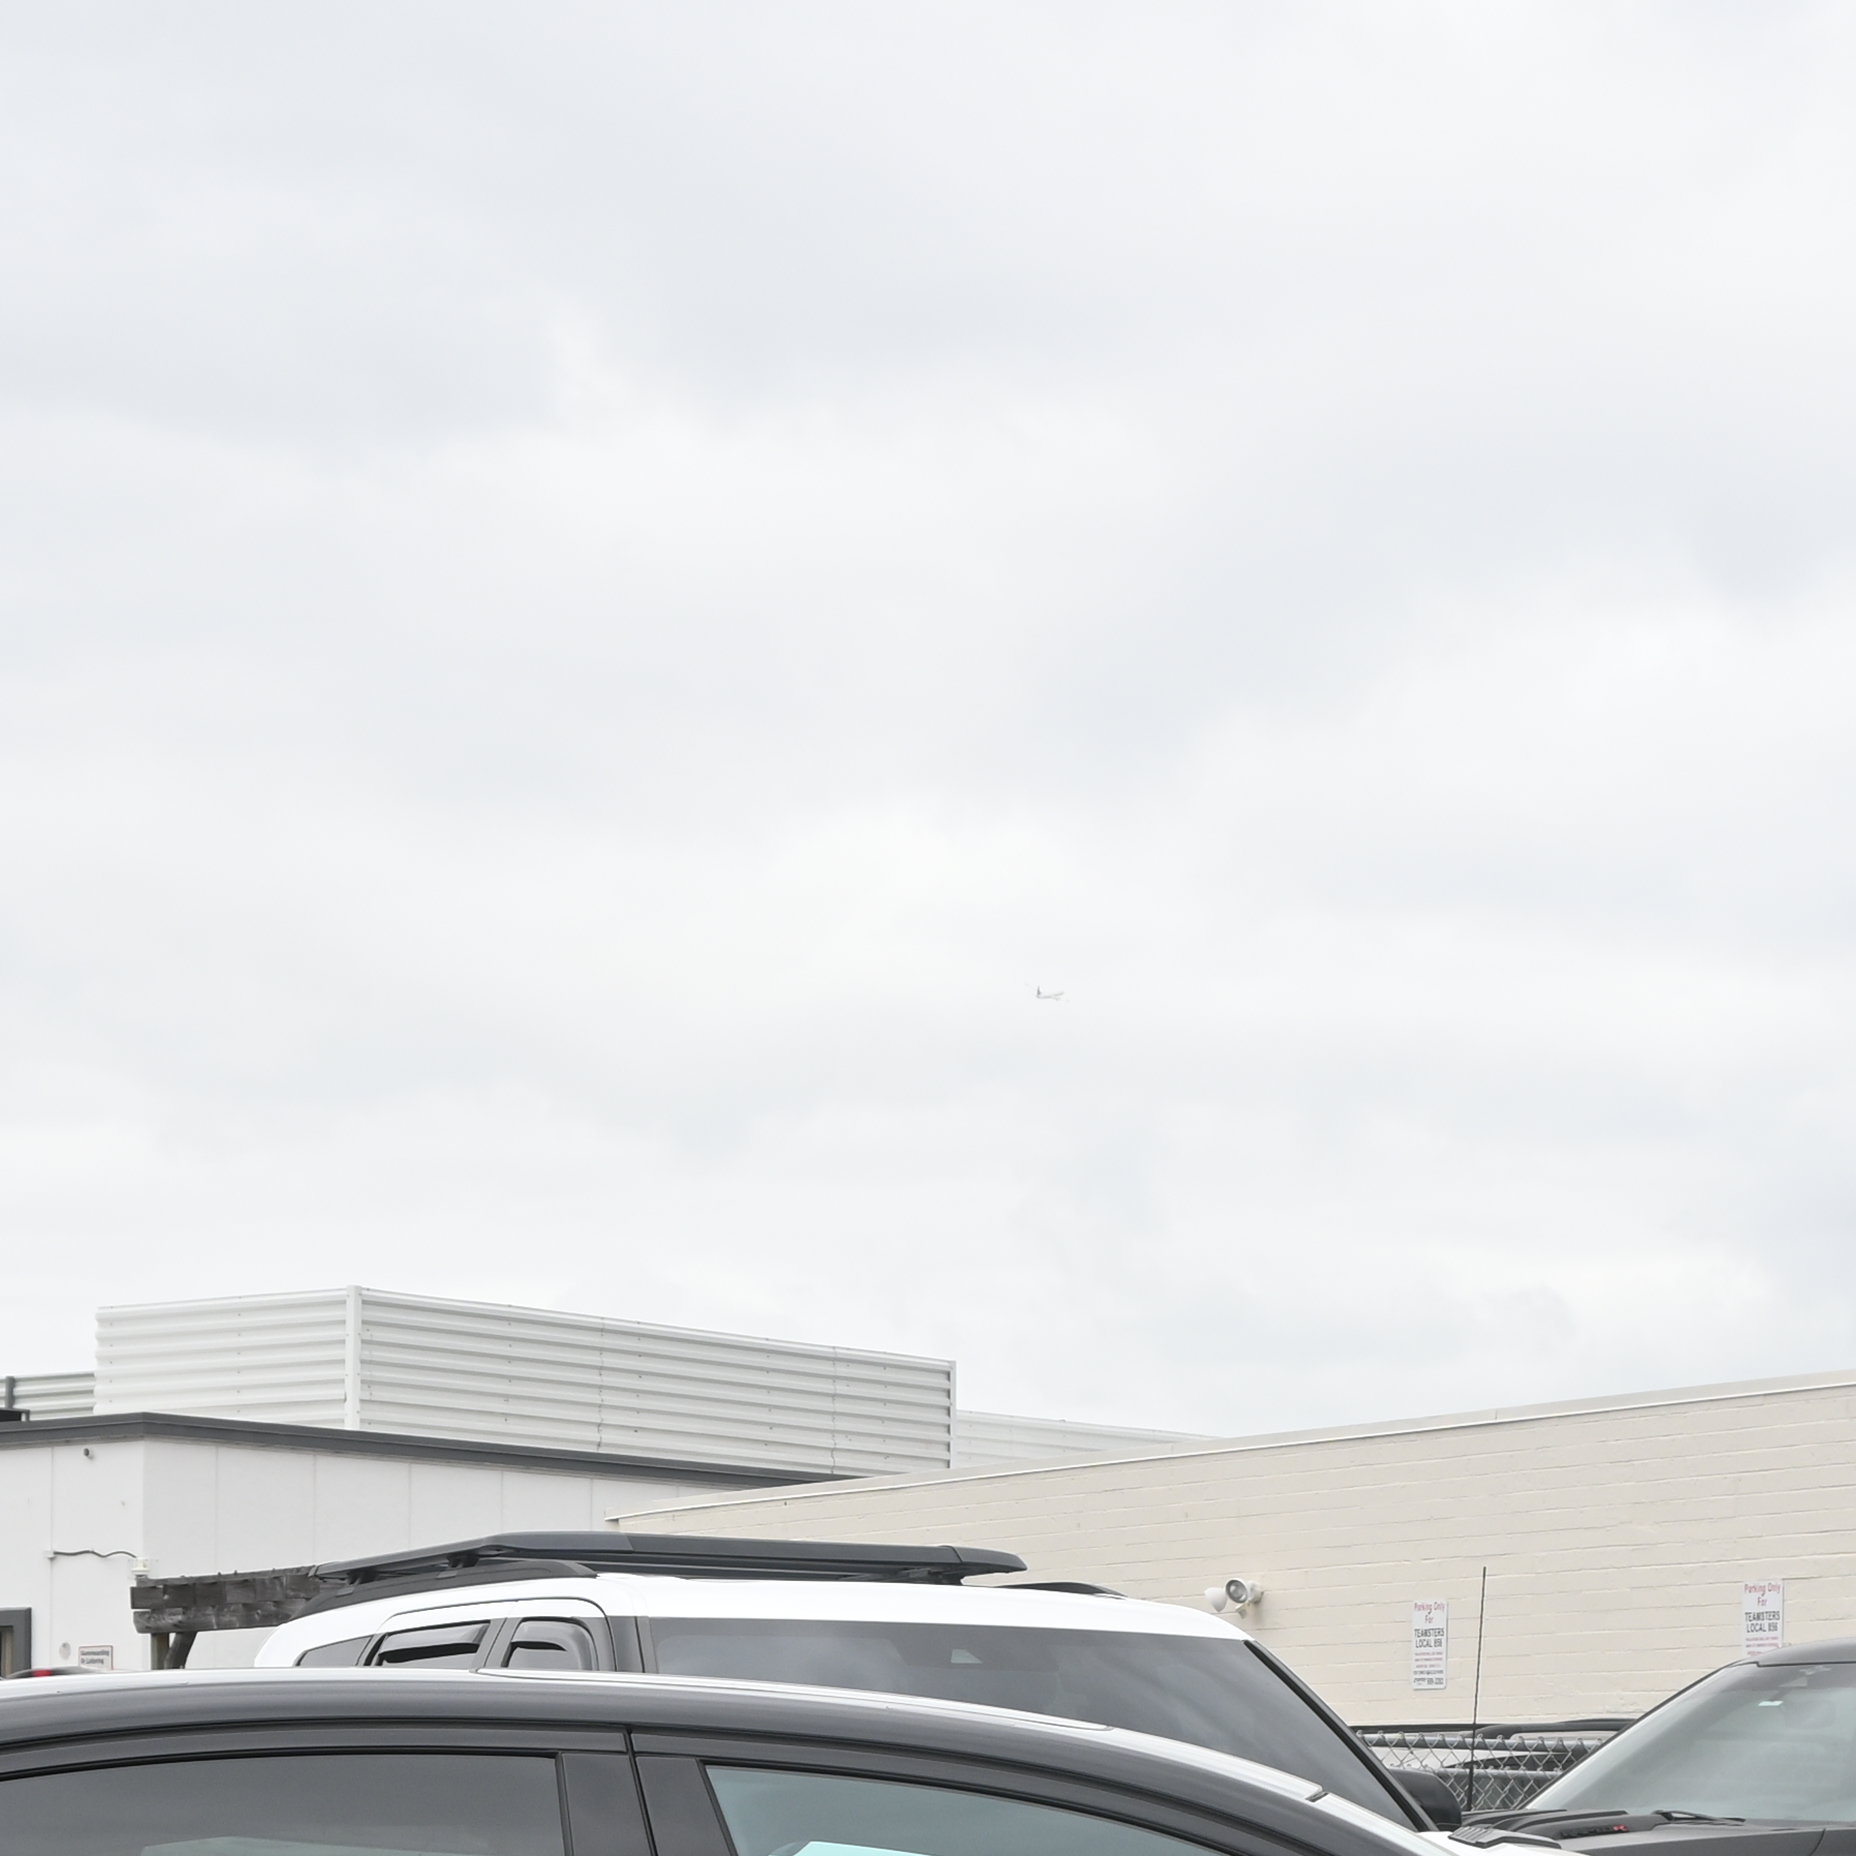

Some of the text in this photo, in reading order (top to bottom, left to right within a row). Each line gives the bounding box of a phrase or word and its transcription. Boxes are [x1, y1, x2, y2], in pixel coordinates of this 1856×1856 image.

[1745, 1582, 1781, 1596] Parking Only
[1415, 1601, 1445, 1615] Parking Only
[1745, 1610, 1781, 1622] TEAMSTERS
[1414, 1628, 1445, 1638] TEAMSTERS
[1746, 1623, 1766, 1633] LOCAL
[1415, 1638, 1433, 1648] LOCAL
